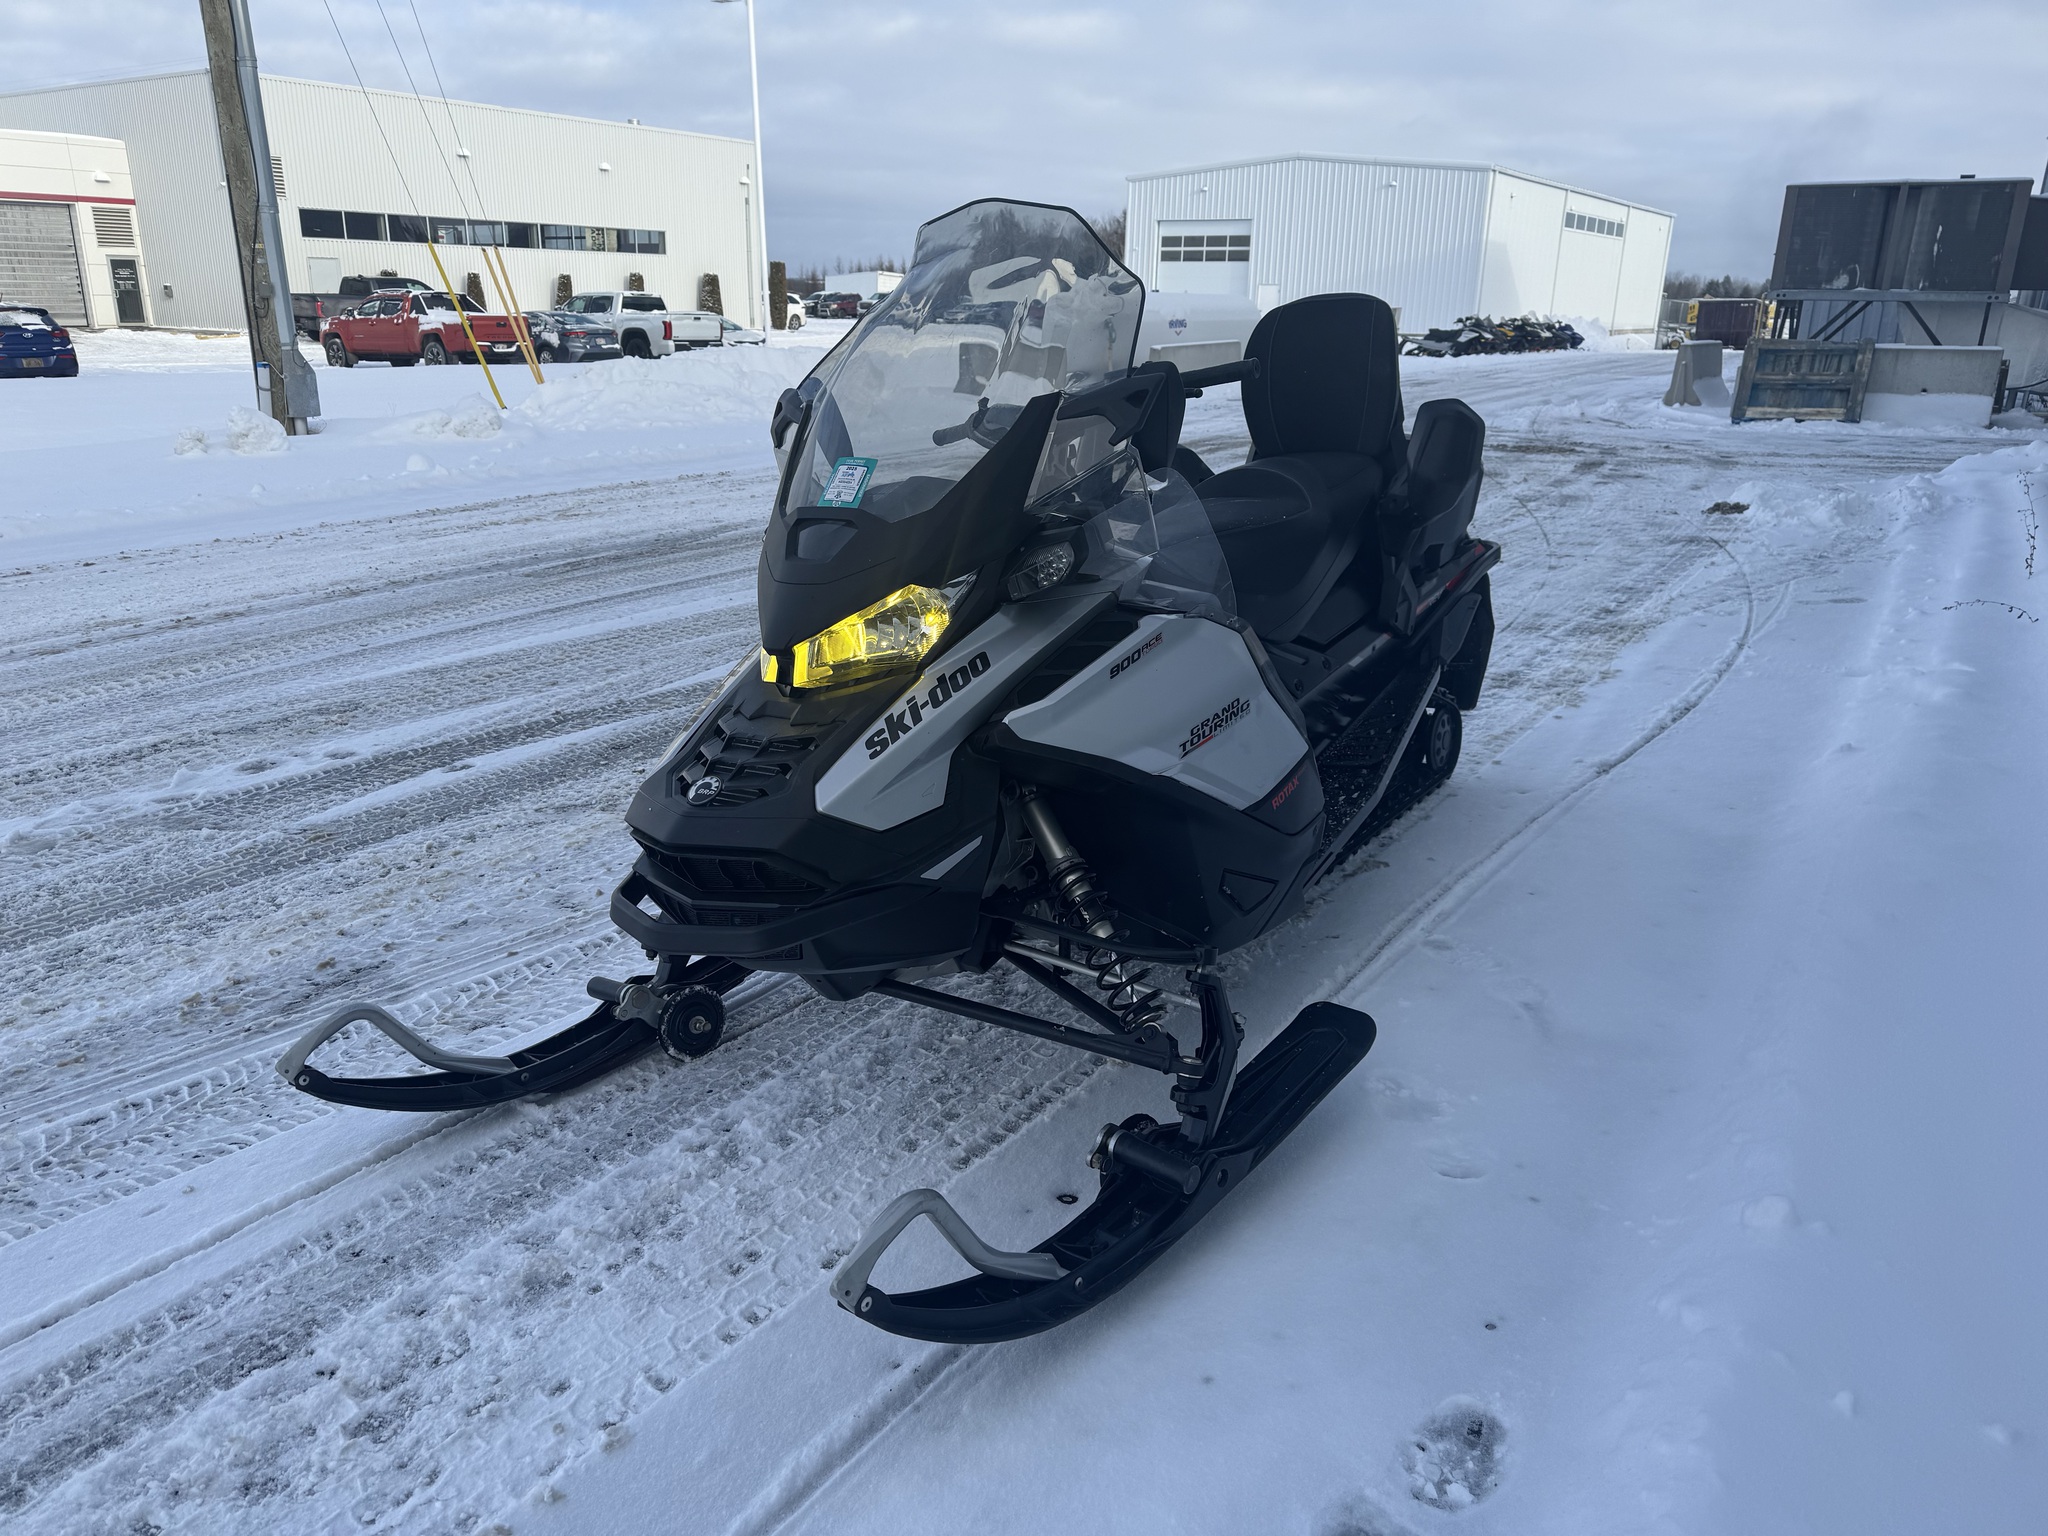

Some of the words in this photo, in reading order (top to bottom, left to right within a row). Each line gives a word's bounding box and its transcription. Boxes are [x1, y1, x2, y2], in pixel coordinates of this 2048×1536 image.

[1110, 648, 1141, 679] 900
[1141, 632, 1162, 652] ACE
[1179, 699, 1250, 753] TOURING
[1190, 697, 1240, 737] GRAND
[1213, 709, 1250, 737] LIMITED
[697, 788, 715, 796] BRP
[1271, 775, 1299, 810] ROTAX
